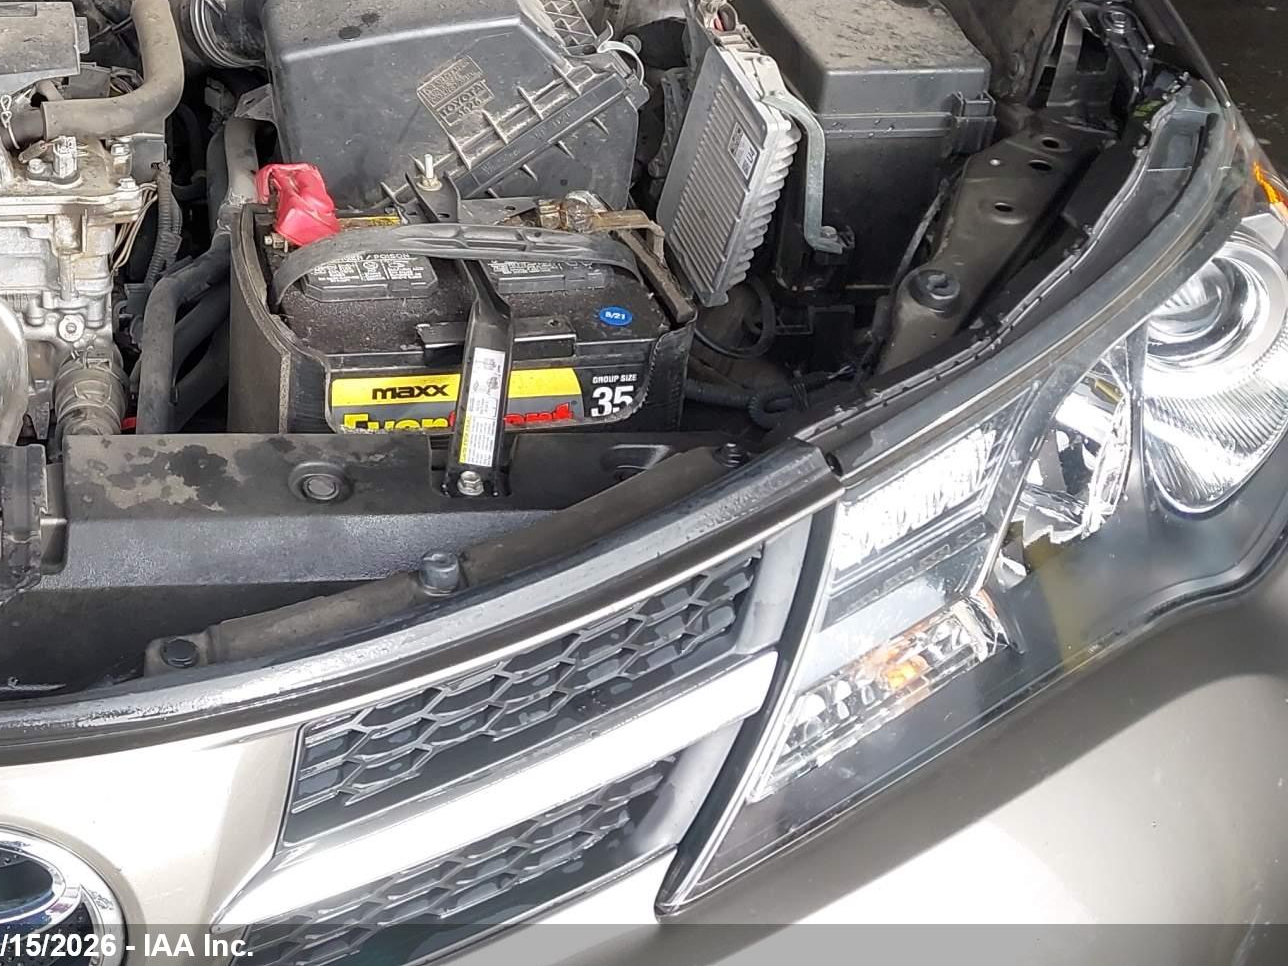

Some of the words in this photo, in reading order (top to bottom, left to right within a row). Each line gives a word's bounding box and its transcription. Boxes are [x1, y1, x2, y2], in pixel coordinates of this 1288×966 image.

[440, 82, 484, 118] TOYOTA
[592, 375, 619, 384] GROUP
[620, 374, 638, 382] SIZE
[372, 384, 450, 400] maxx
[591, 385, 634, 417] 35
